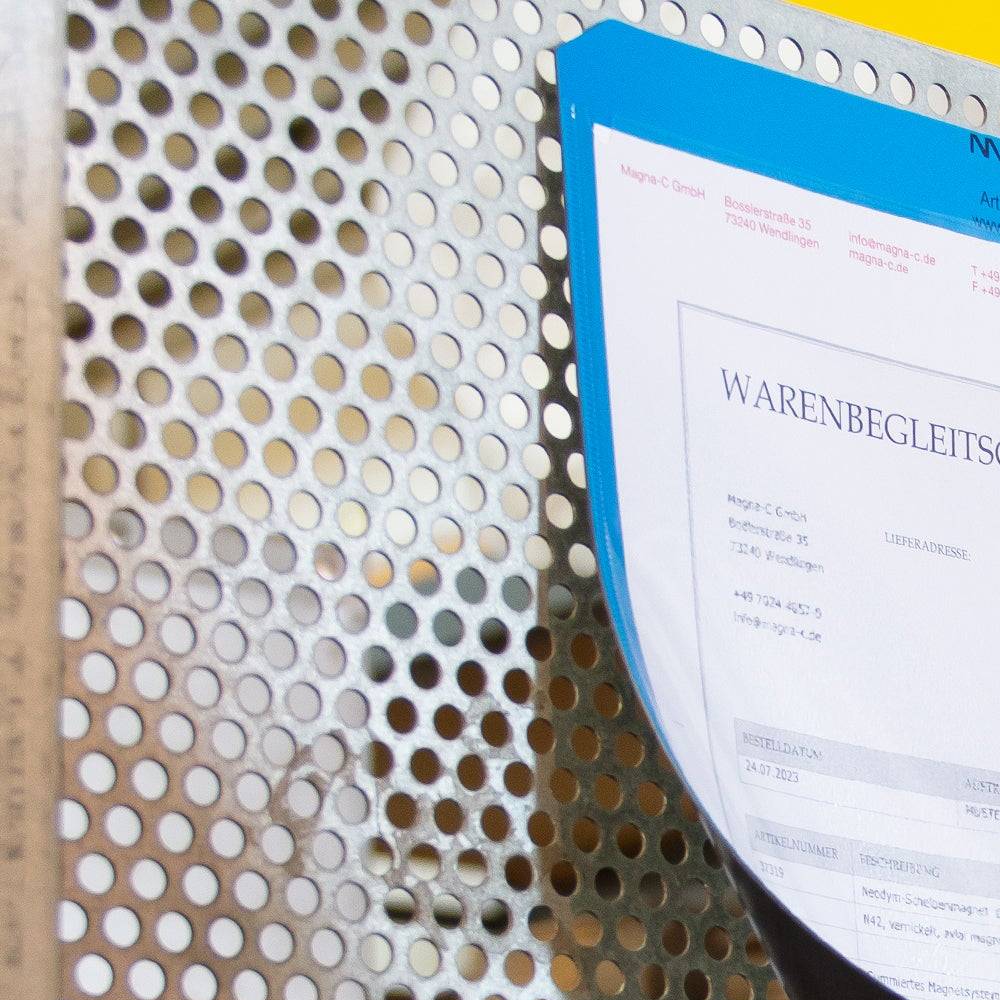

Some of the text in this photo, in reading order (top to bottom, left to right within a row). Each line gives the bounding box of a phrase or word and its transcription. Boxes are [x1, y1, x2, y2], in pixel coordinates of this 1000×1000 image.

[620, 163, 706, 201] Magna-C GmbH
[725, 211, 820, 249] 73240 Wendlingen
[798, 217, 812, 231] 35
[848, 232, 936, 266] info@magna-c.de
[848, 250, 909, 274] magna-c.de
[970, 264, 978, 277] T
[981, 270, 1000, 283] +49
[745, 759, 800, 783] 24.07.2023
